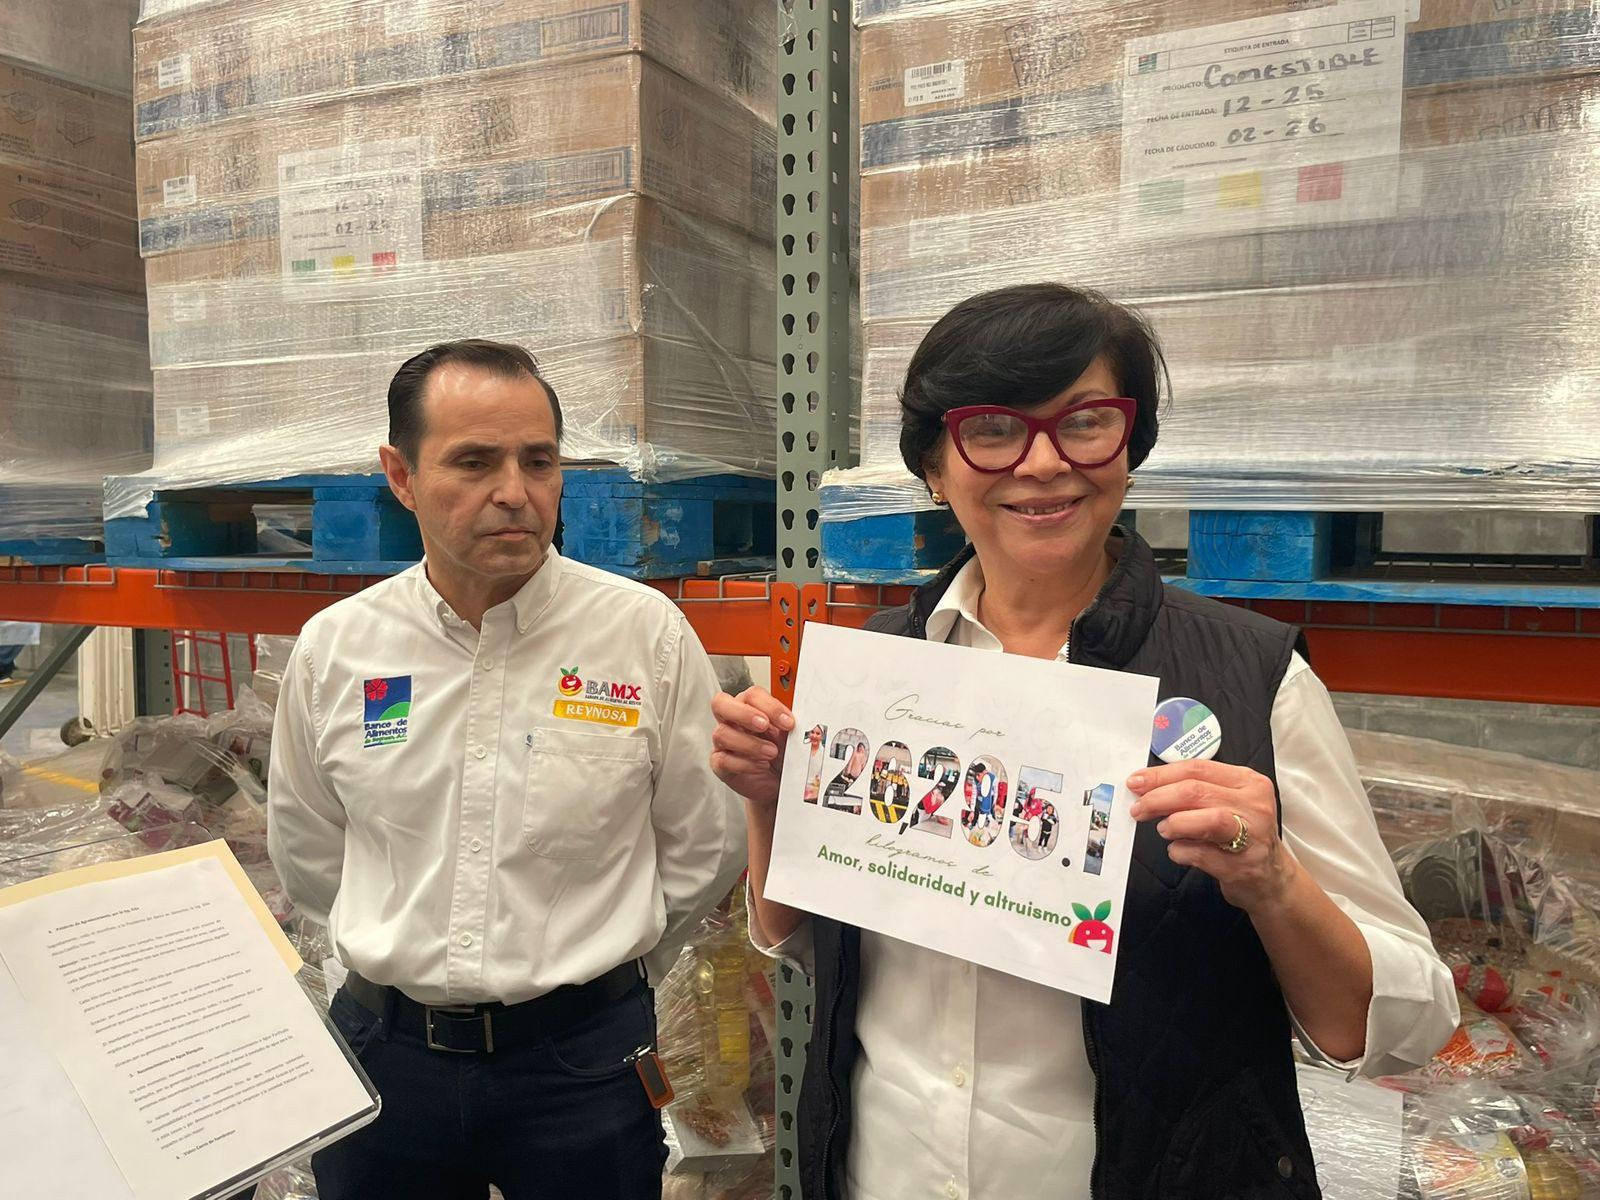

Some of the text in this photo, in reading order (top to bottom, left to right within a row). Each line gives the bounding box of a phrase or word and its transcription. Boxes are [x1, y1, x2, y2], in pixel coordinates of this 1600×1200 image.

[1223, 38, 1290, 55] ETIQUETA DE ENTRADA
[1162, 80, 1204, 92] PRODUCTO:
[1180, 108, 1218, 119] ENTRADA:
[1144, 140, 1217, 156] FECHA DE CADUCIDAD:
[585, 680, 642, 701] BAMX
[565, 703, 628, 722] REYNOSA
[884, 693, 1006, 740] Gracias por
[364, 718, 408, 731] Banco de
[365, 726, 408, 739] Alimentos
[1174, 724, 1207, 751] Banco de
[1180, 730, 1211, 756] Alimentos
[864, 833, 994, 877] kilogramos de
[816, 844, 1072, 928] Amor, solidaridad y altruismo
